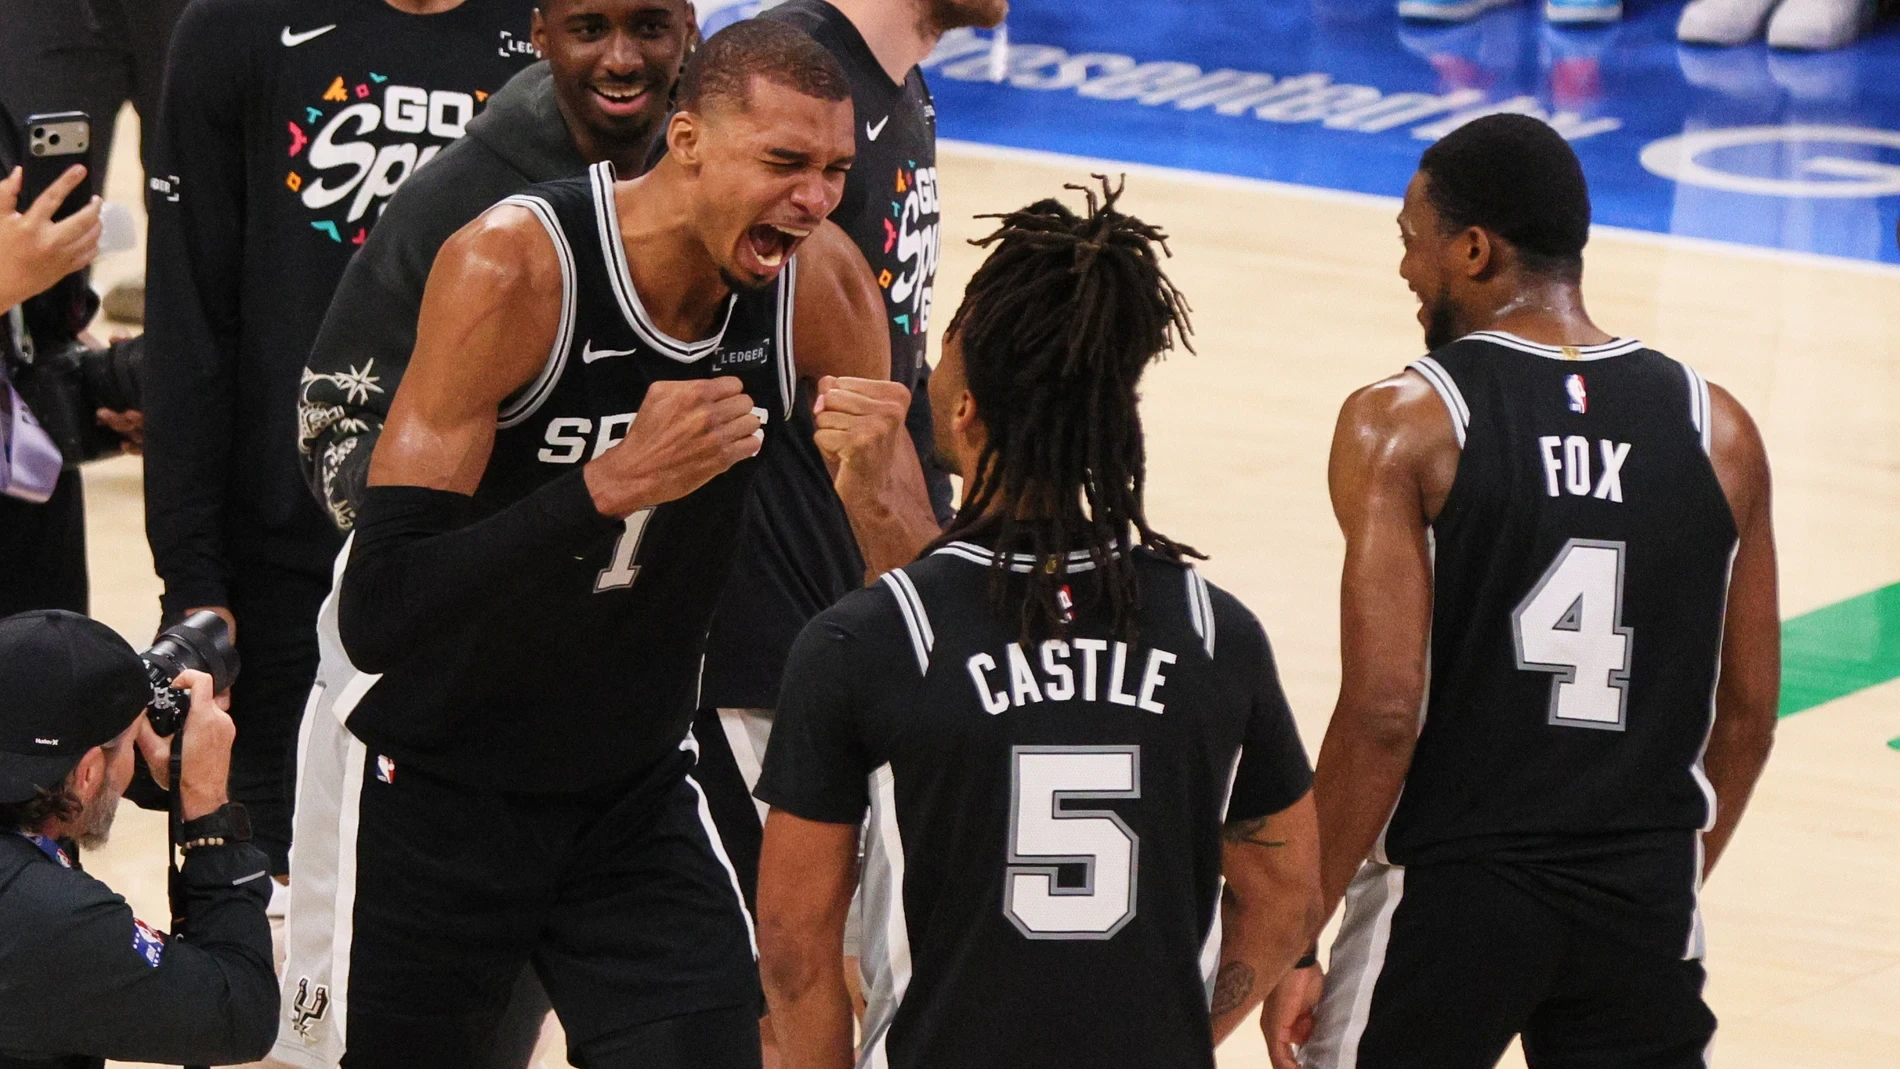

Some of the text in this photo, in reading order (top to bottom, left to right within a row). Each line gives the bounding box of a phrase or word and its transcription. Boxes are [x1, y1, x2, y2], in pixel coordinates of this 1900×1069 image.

[384, 85, 473, 138] GO
[921, 27, 1483, 134] resented
[720, 347, 764, 364] LEDGER
[1538, 435, 1631, 503] FOX
[593, 505, 657, 594] 1
[966, 638, 1177, 715] CASTLE
[1511, 538, 1634, 732] 4
[1003, 745, 1140, 940] 5
